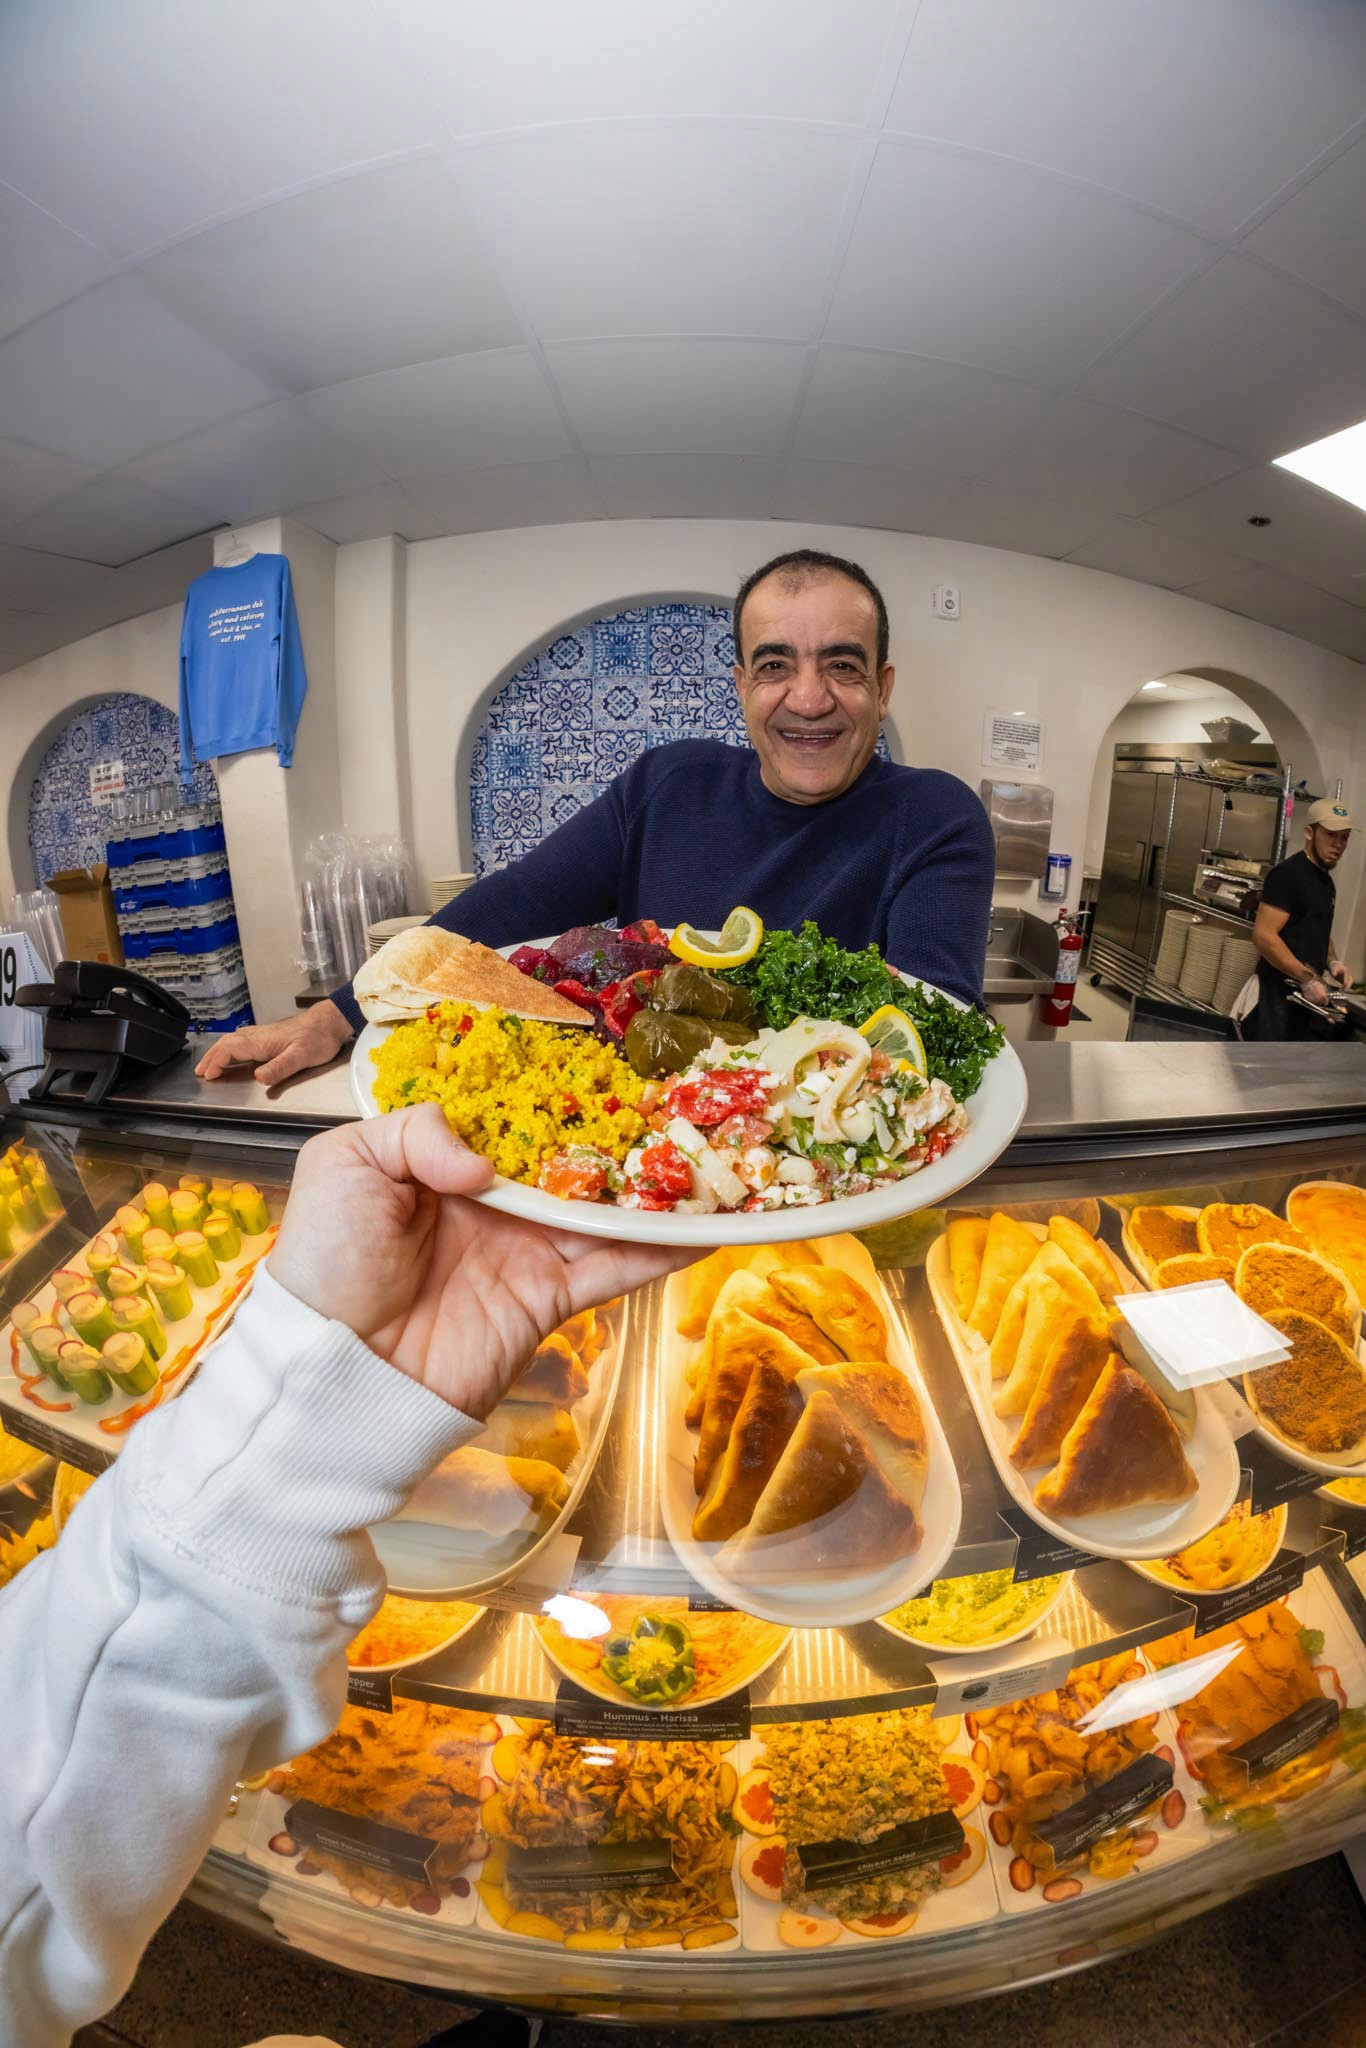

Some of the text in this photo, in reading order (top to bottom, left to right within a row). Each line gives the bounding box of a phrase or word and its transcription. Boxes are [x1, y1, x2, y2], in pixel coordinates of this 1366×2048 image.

[252, 600, 264, 609] deli
[224, 615, 239, 623] and
[349, 1678, 376, 1689] epper
[603, 1711, 650, 1722] Hummus
[661, 1713, 699, 1722] Harissa
[857, 1858, 892, 1872] Chicken
[893, 1851, 917, 1864] Salad
